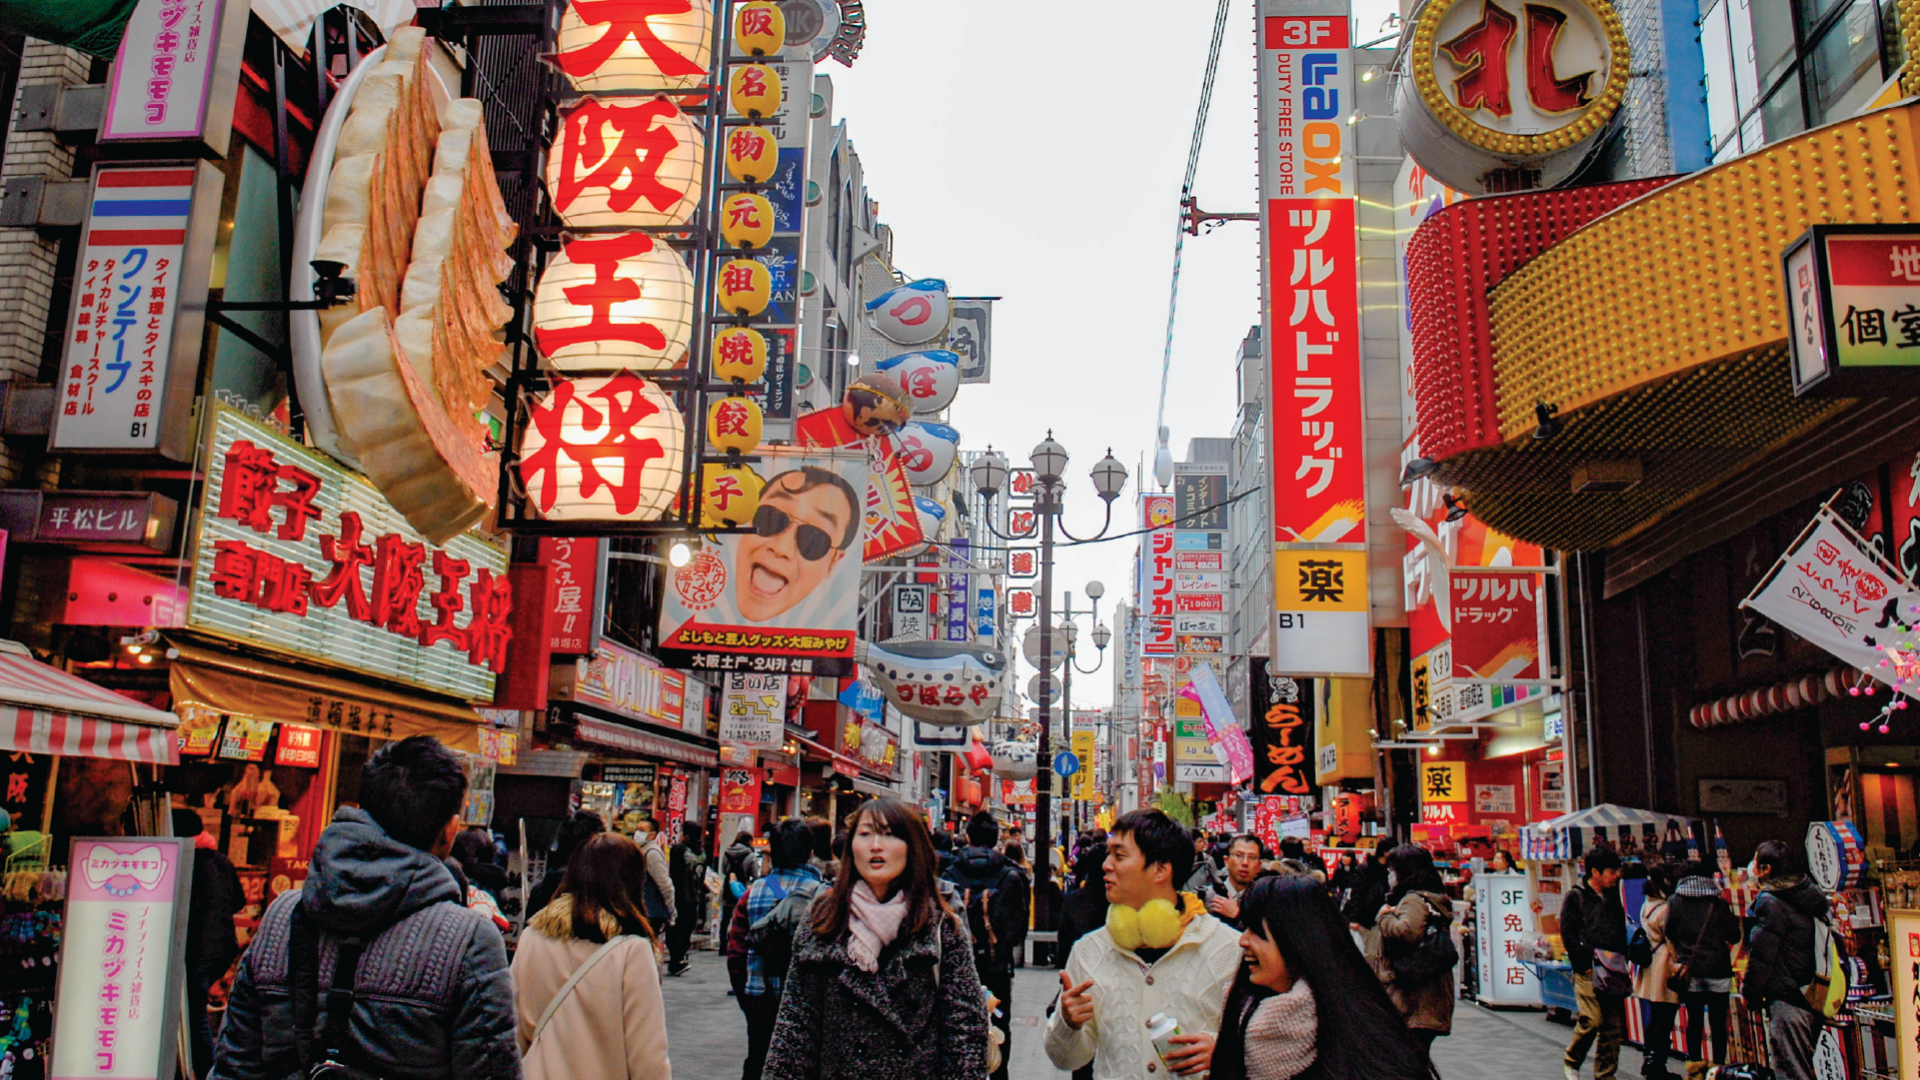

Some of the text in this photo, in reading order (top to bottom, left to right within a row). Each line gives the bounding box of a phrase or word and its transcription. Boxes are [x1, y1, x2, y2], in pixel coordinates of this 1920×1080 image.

[145, 0, 187, 124] ヅキモモコ
[1283, 21, 1331, 45] 3F
[1438, 0, 1597, 117] 北
[1277, 54, 1294, 195] DUTY FREE STORE
[520, 0, 710, 515] 大阪王将
[64, 259, 98, 416] タイ調味料 食材店
[82, 259, 116, 415] タイカルチャースクール
[105, 248, 148, 393] クンテープ
[134, 258, 170, 418] タイ料理とタイスキの店
[1288, 209, 1342, 498] ツルハドラッグ
[130, 422, 147, 438] B1
[50, 507, 138, 531] 平松ビル
[1011, 470, 1033, 613] かに道楽
[307, 511, 512, 674] 大阪王将
[551, 537, 582, 634] うてぇ屋!!
[1152, 532, 1173, 643] ジャンカラ
[1279, 613, 1305, 629] B1
[1299, 559, 1343, 602] 薬
[1453, 578, 1533, 601] ツルハ
[1455, 607, 1518, 624] ドラッグ
[678, 629, 848, 651] よしもと芸人グッズ・大阪みやげ
[896, 683, 989, 706] づぼらや
[1183, 724, 1205, 732] サイゼ
[1184, 767, 1216, 777] ZAZA
[1260, 703, 1310, 794] らーめん
[1427, 766, 1452, 797] 薬
[90, 858, 160, 870] ミカヅキモモコ
[1501, 890, 1524, 905] 3F
[96, 911, 128, 1071] ミカヅキモモコ
